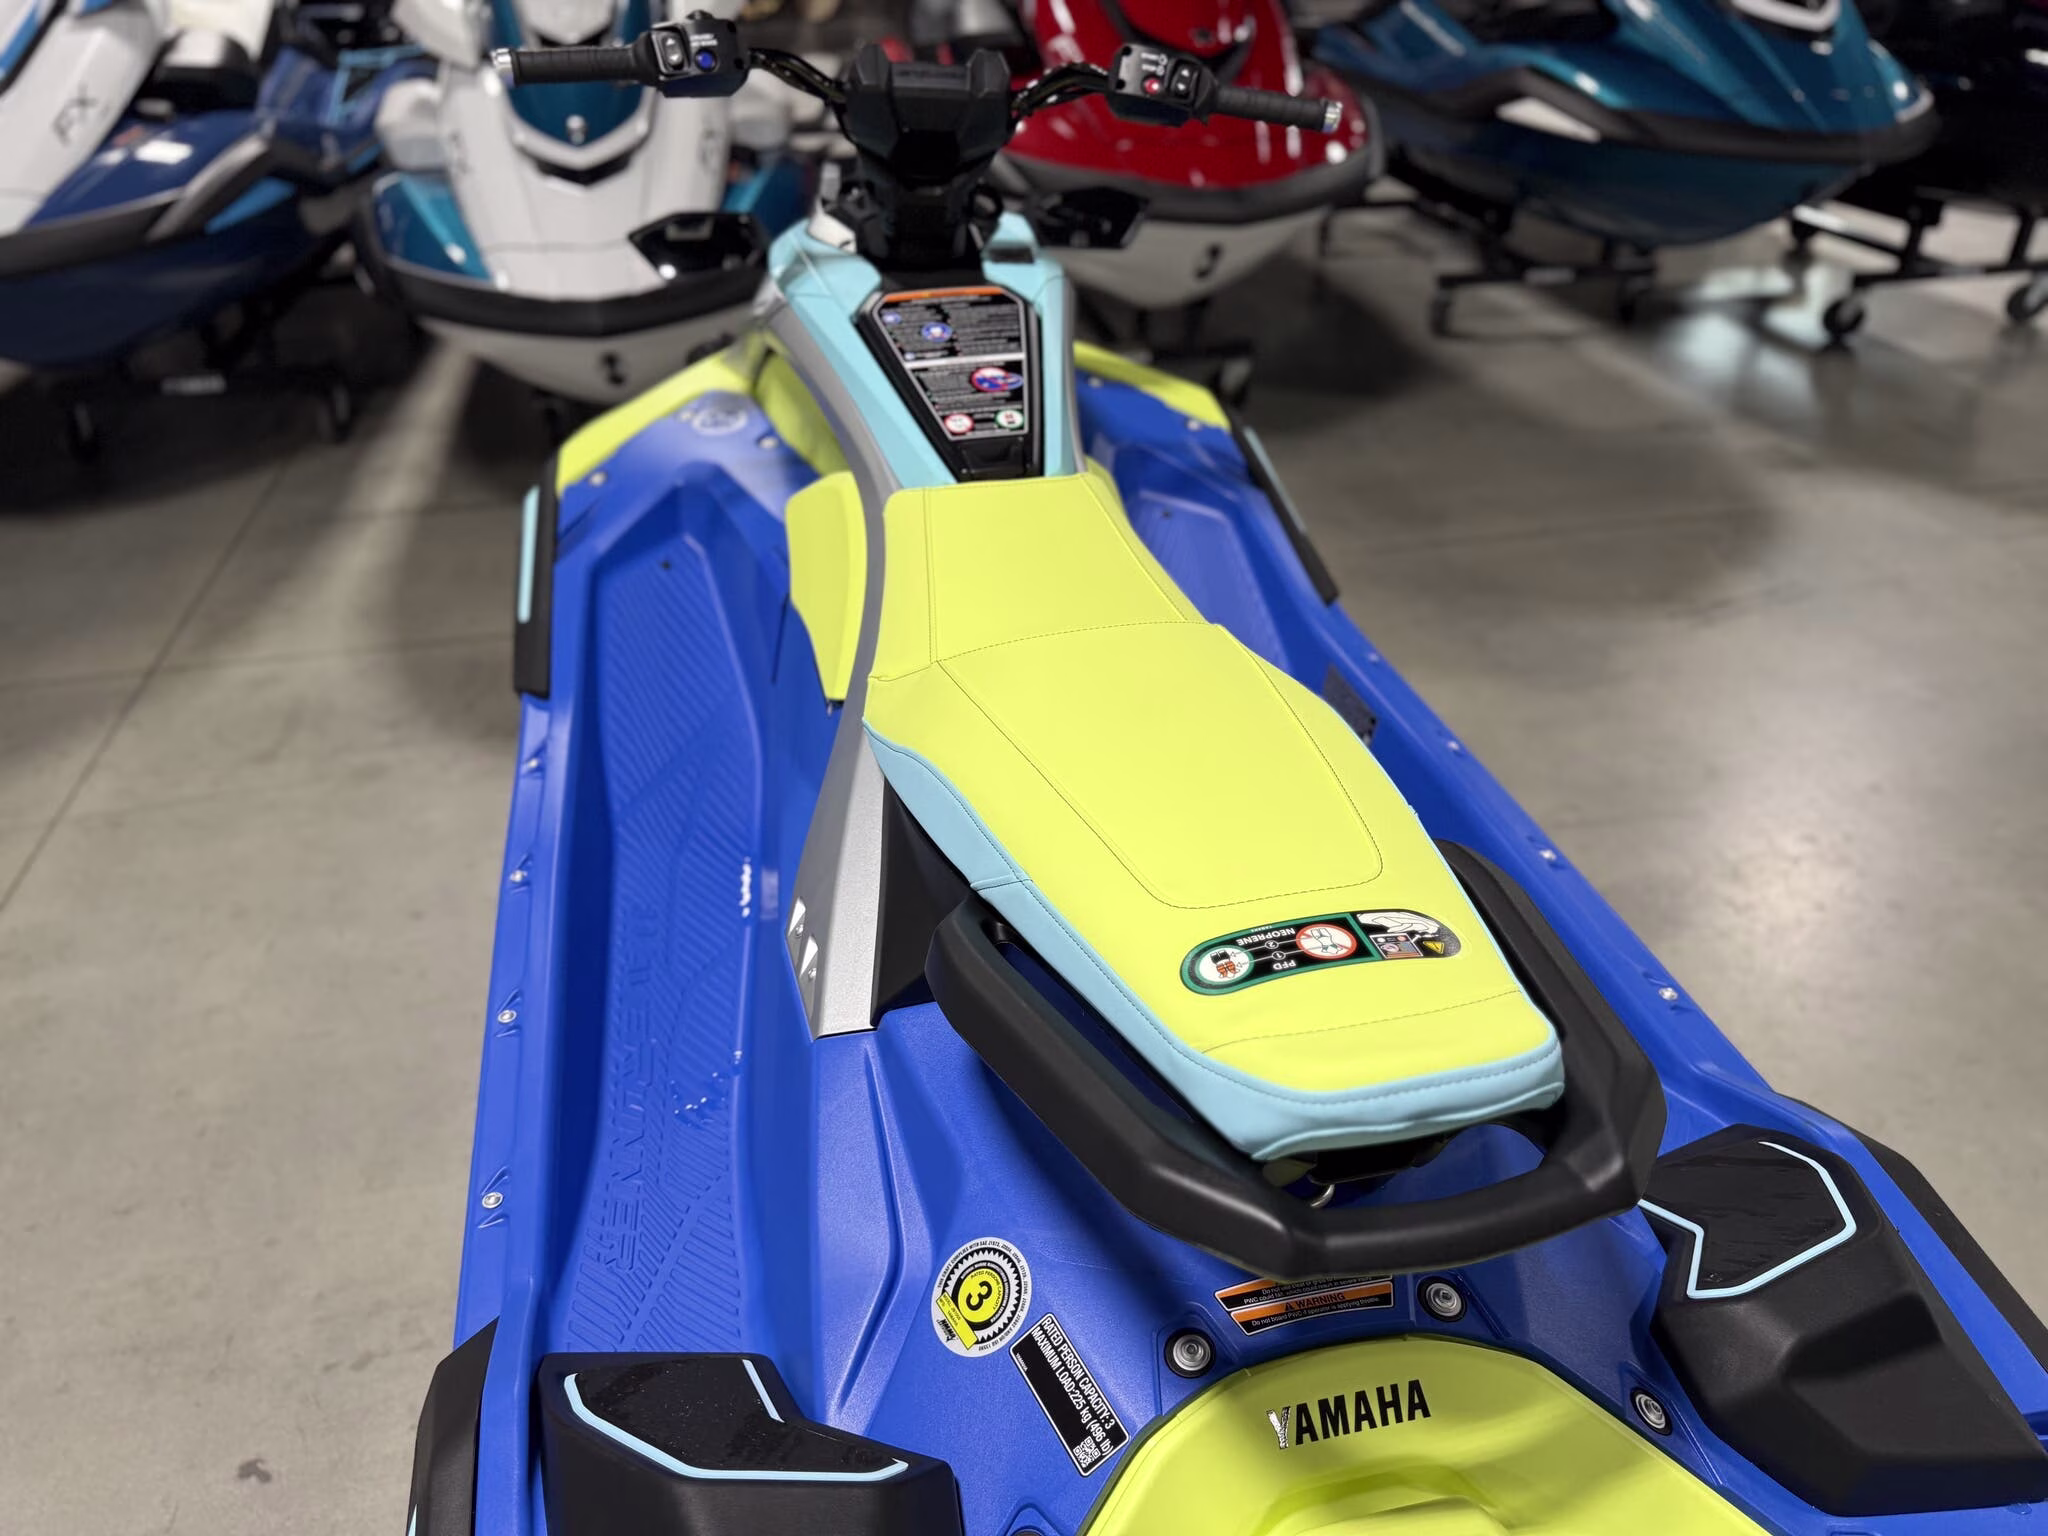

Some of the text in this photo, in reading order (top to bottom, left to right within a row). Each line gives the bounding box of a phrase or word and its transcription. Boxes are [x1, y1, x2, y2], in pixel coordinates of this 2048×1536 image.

[1235, 927, 1296, 946] NEOPRENE
[1272, 959, 1297, 971] PFD
[965, 1280, 992, 1311] 3
[1243, 1296, 1258, 1304] PWC
[1258, 1292, 1274, 1301] could
[1296, 1292, 1346, 1309] WARNING
[1270, 1313, 1287, 1322] board
[1287, 1310, 1302, 1318] PWC
[1336, 1300, 1359, 1309] applying
[1041, 1317, 1116, 1430] RATED PERSON CAPACITY: 3
[1031, 1326, 1114, 1456] MAXIMUM LOAD:225 kg (496 lb)
[1266, 1379, 1431, 1450] YAMAHA
